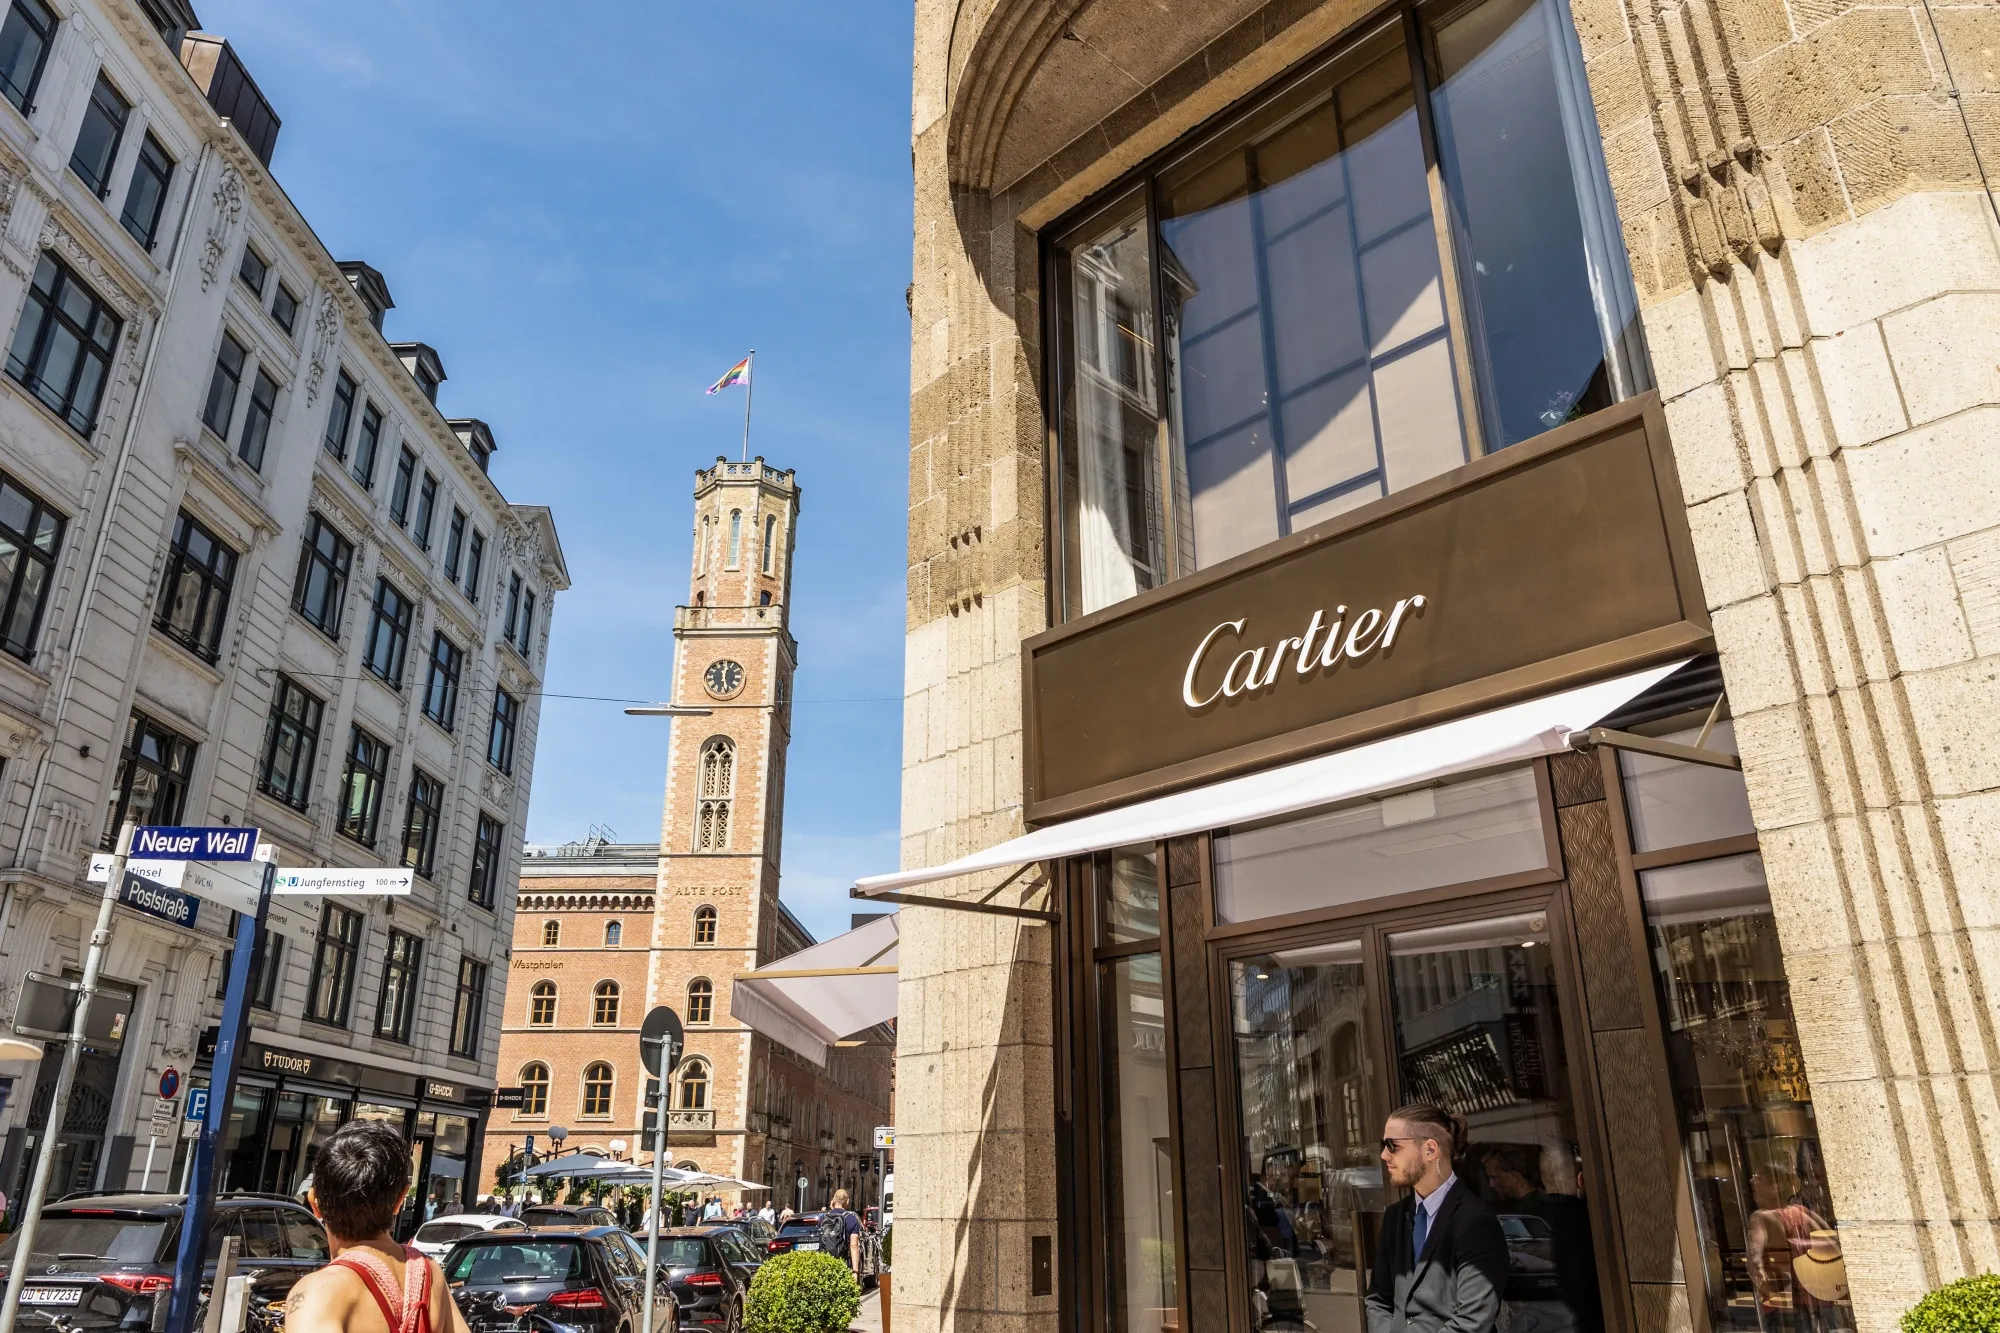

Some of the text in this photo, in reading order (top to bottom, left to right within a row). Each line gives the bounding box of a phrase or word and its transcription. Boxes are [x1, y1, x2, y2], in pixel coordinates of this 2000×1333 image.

[1182, 594, 1427, 708] Cartier
[139, 830, 249, 854] Neuer Wall
[300, 877, 365, 889] Jungfernstieg
[375, 878, 388, 886] 100
[675, 886, 743, 896] ALTE POST
[128, 880, 189, 921] Poststraße
[511, 959, 564, 971] Westphalen
[272, 1054, 303, 1072] TUDOR
[429, 1083, 454, 1098] G-SHOCK
[192, 1093, 208, 1117] P
[21, 1288, 35, 1300] OD
